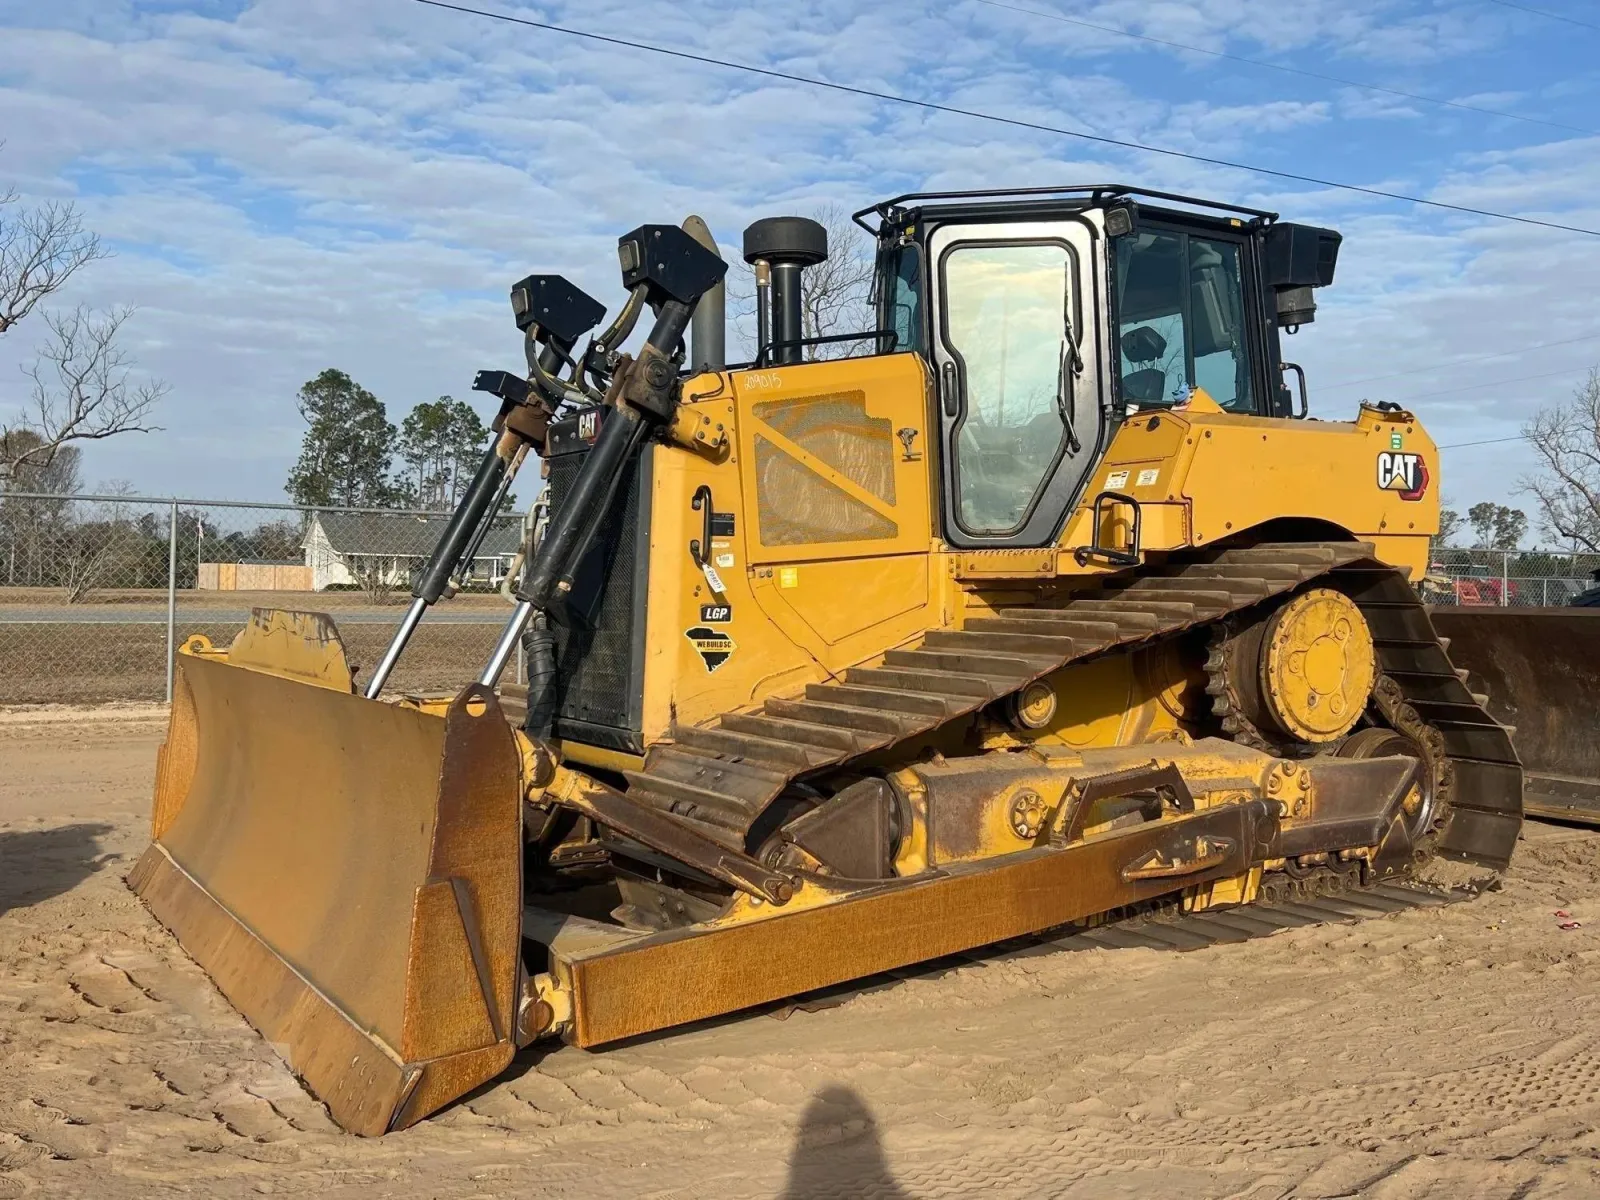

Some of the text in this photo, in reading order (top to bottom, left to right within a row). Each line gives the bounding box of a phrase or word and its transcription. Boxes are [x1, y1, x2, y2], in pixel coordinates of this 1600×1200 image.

[744, 373, 781, 390] 209015
[579, 412, 596, 438] CAT
[1378, 452, 1417, 490] CAT
[705, 607, 728, 620] LGP
[697, 640, 732, 648] WE BUILD SC
